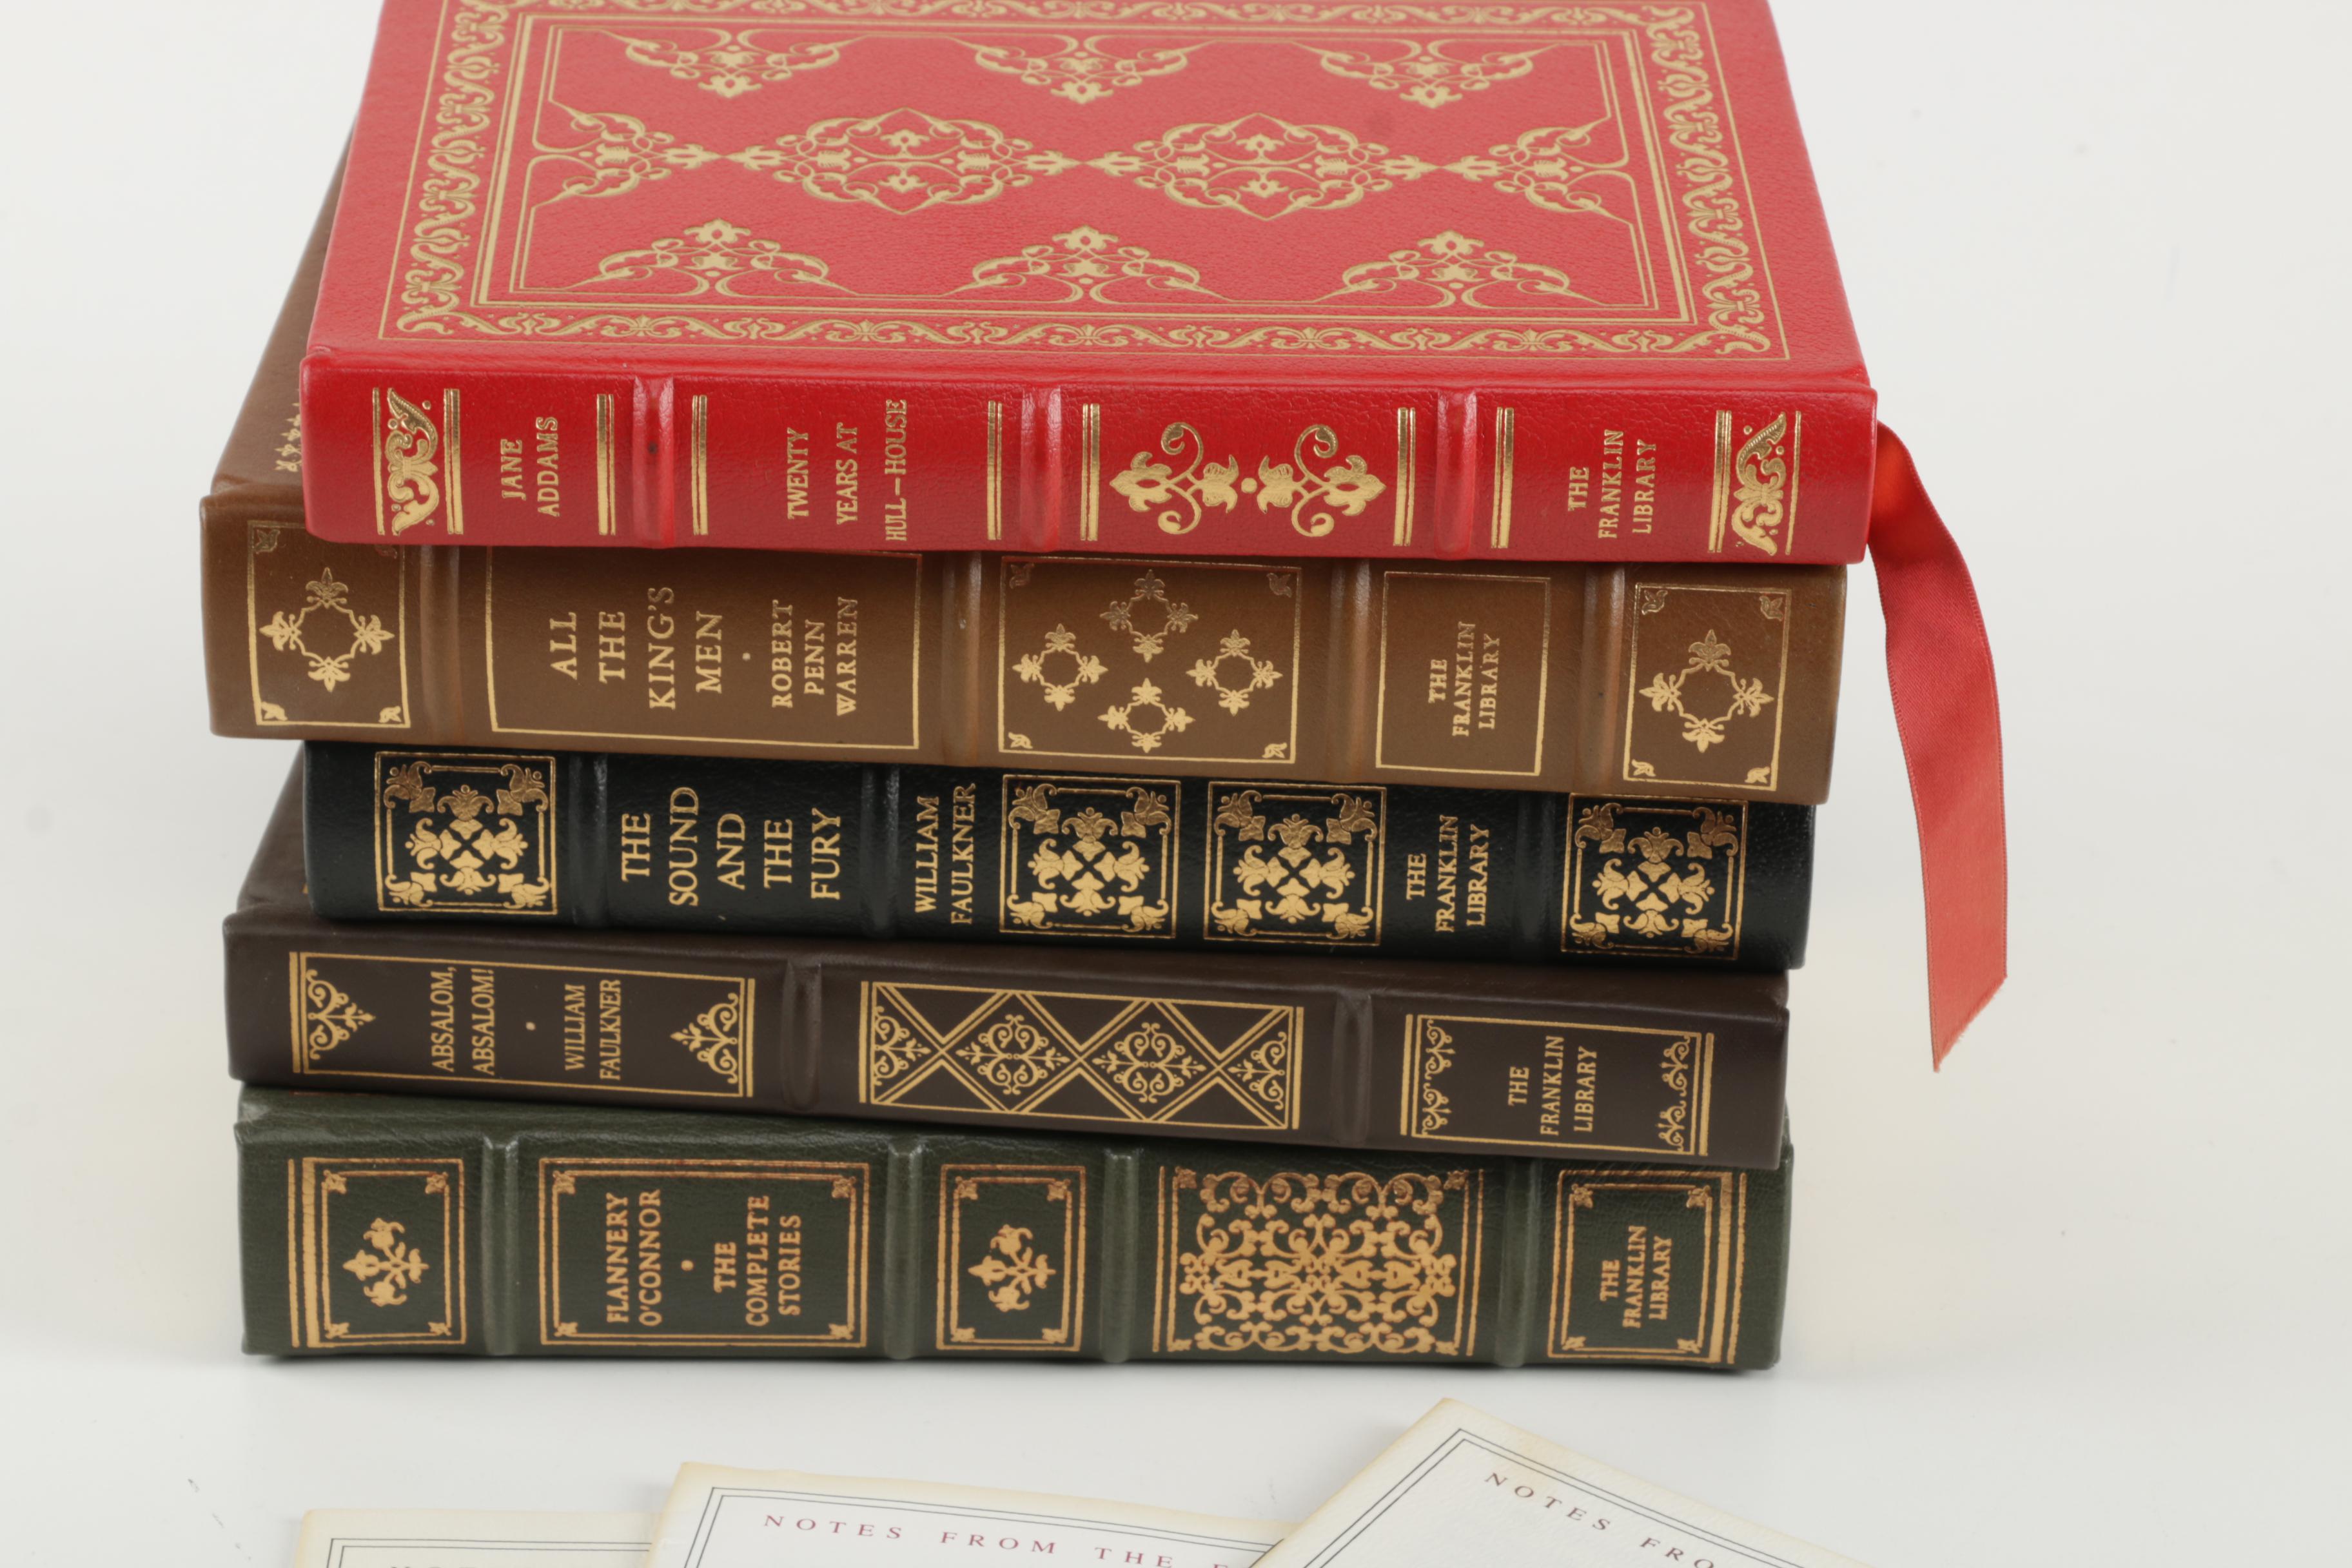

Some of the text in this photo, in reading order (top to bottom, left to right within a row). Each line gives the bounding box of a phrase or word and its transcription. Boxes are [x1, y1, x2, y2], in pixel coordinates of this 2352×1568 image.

[500, 438, 527, 501] JANE
[536, 416, 560, 517] ADDAMS
[787, 427, 809, 520] TWENTY
[836, 422, 858, 525] YEARS AT
[1567, 466, 1590, 512] THE
[1598, 429, 1624, 539] FRANKLIN
[1632, 439, 1657, 534] LIBRARY
[549, 611, 578, 681] ALL
[598, 611, 626, 684] THE
[647, 587, 676, 710] KING'S
[695, 611, 723, 694] MEN
[771, 599, 794, 709] ROBERT
[803, 619, 825, 696] PENN
[836, 596, 859, 717] WARREN
[1427, 659, 1448, 704] THE
[1451, 621, 1476, 737] FRANKLIN
[1478, 633, 1501, 730] LIBRARY
[621, 813, 651, 881] THE
[668, 787, 700, 906] SOUND
[717, 813, 746, 890] AND
[763, 818, 793, 888] THE
[810, 807, 841, 900] FURY
[914, 796, 940, 913] WILLIAM
[950, 782, 977, 925] FAULKNER
[1406, 853, 1427, 901] THE
[1435, 814, 1459, 932] FRANKLIN
[1465, 823, 1490, 926] LIBRARY
[429, 966, 457, 1073] ABSALOM,
[470, 968, 495, 1076] ABSALOM!
[564, 983, 586, 1072] WILLIAM
[599, 979, 622, 1081] FAULKNER
[1507, 1066, 1530, 1107] THE
[1540, 1035, 1565, 1137] FRANKLIN
[1573, 1045, 1598, 1133] LIBRARY
[605, 1192, 630, 1324] FLANNERY
[638, 1188, 663, 1327] O'CONNOR
[713, 1241, 737, 1293] THE
[745, 1195, 770, 1327] COMPLETE
[778, 1215, 802, 1317] STORIES
[1599, 1259, 1621, 1302] THE
[1622, 1225, 1647, 1329] FRANKLIN
[1648, 1235, 1672, 1321] LIBRARY
[763, 1514, 1173, 1568] NOTES FROM THE
[1484, 1472, 1611, 1531] NOTES
